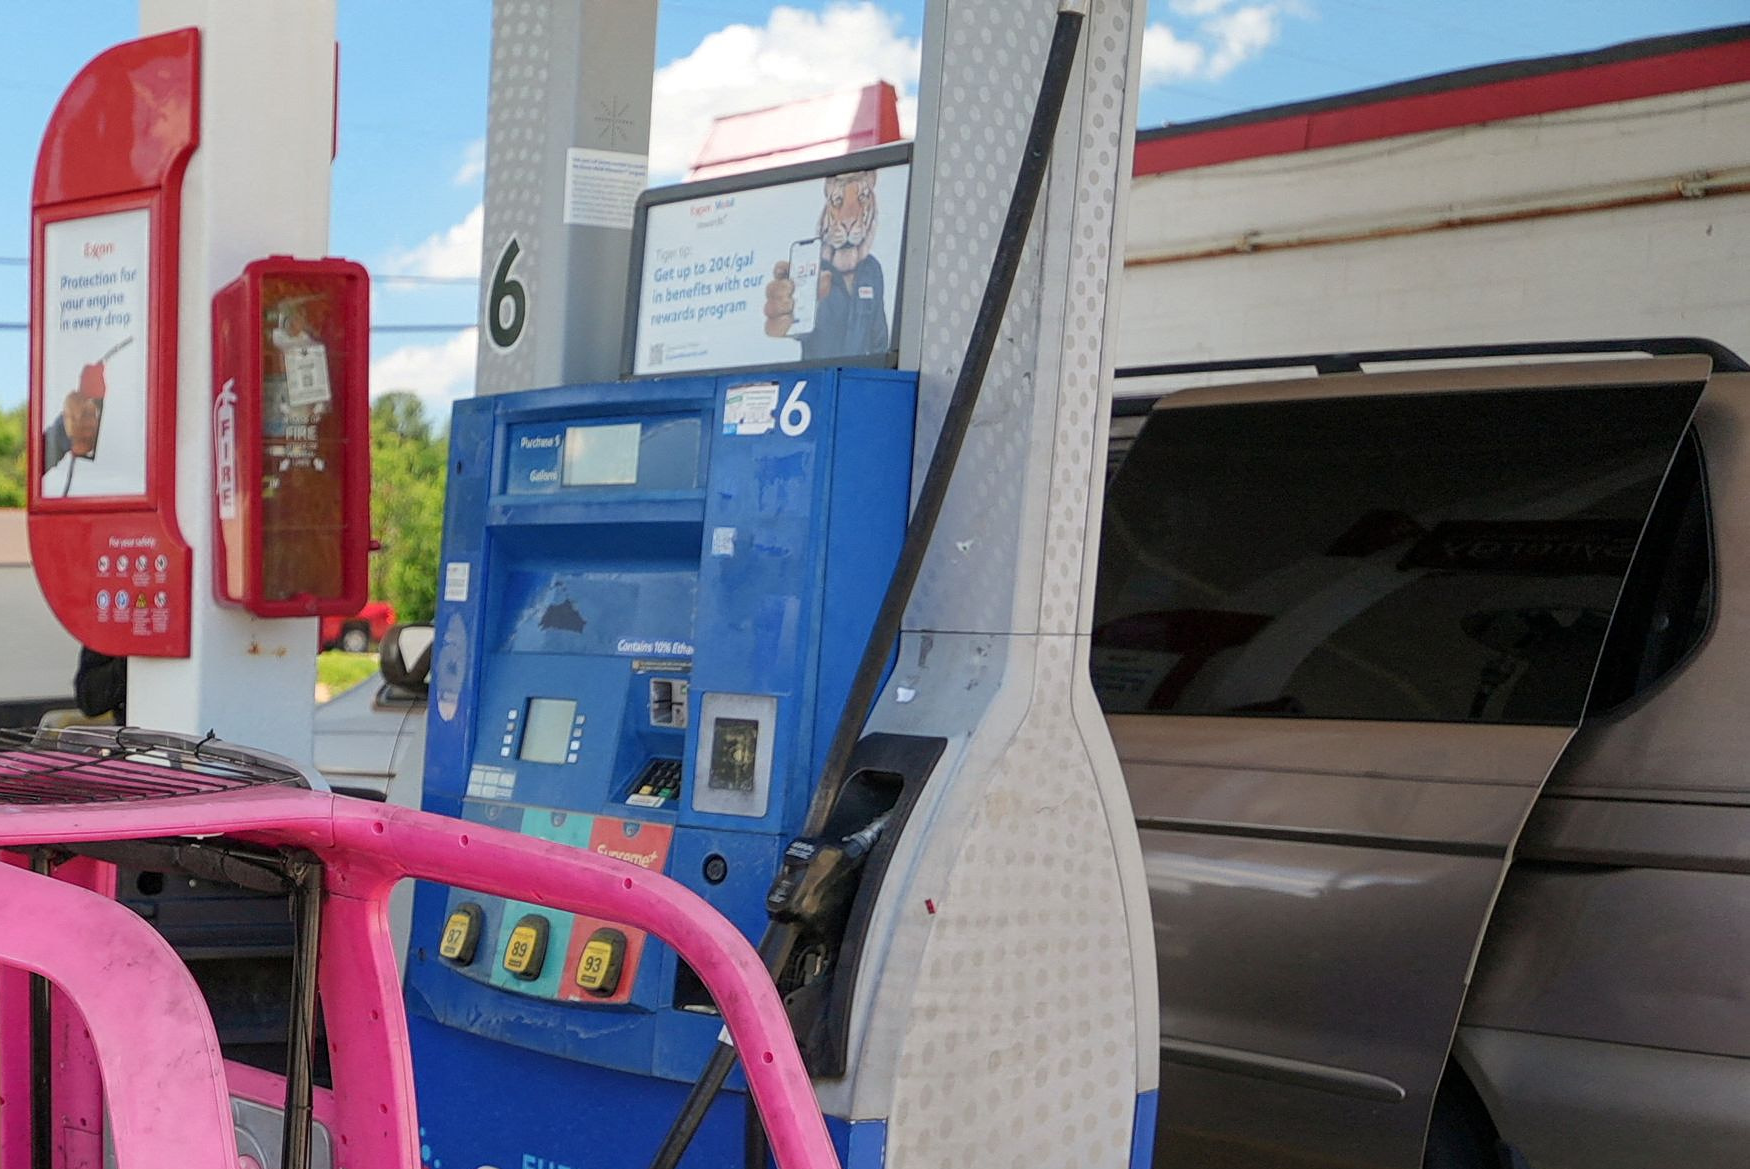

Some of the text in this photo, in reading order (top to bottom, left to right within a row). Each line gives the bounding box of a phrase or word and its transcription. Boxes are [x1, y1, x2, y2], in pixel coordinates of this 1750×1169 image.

[60, 266, 137, 289] Protection for
[654, 266, 674, 282] Get
[677, 266, 691, 281] up
[694, 263, 705, 275] to
[487, 236, 528, 350] 6
[652, 274, 765, 304] in benefits with our
[60, 291, 125, 316] your engine
[650, 300, 747, 326] rewards program
[59, 311, 132, 332] in every drop
[780, 381, 811, 436] 6
[286, 425, 317, 441] FIRE
[221, 419, 232, 506] FIRE
[618, 640, 652, 653] Contains
[654, 641, 671, 654] 10%
[447, 928, 462, 944] 87
[512, 940, 528, 957] 89
[584, 955, 603, 973] 93
